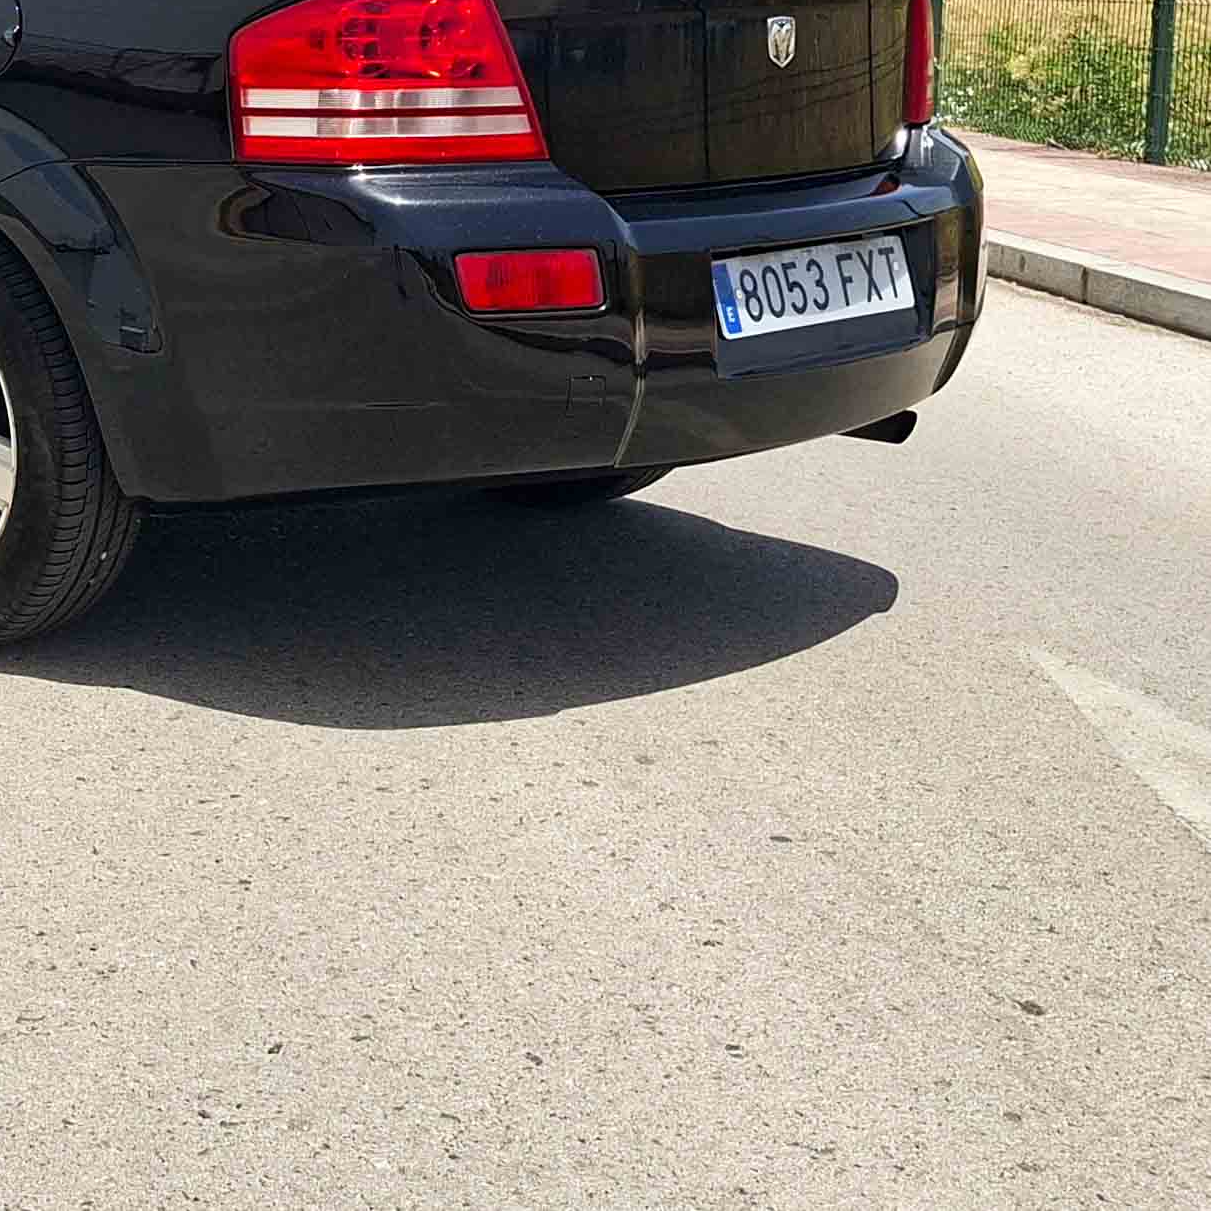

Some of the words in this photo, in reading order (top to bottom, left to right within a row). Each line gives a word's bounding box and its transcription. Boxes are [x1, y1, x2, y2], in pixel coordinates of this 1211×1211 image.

[725, 307, 735, 324] E
[739, 258, 830, 323] 8053
[835, 246, 898, 307] FXT
